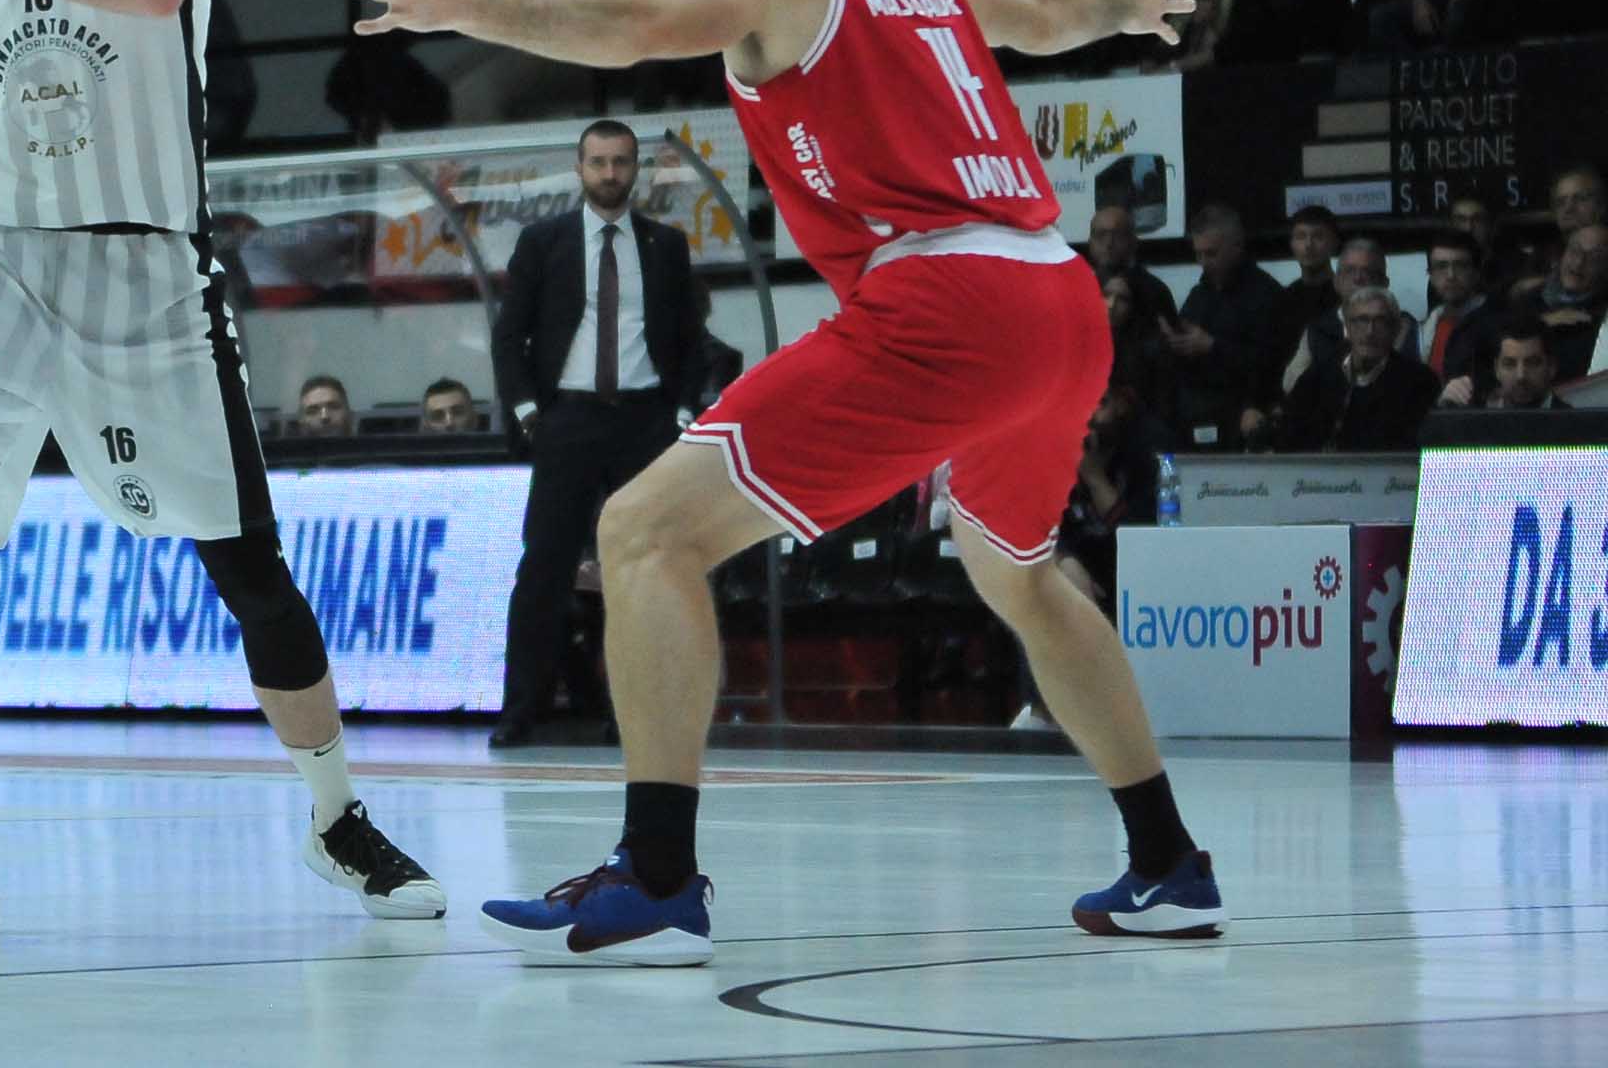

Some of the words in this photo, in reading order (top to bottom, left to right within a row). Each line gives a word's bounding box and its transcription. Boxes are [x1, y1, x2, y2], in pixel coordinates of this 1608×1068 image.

[74, 25, 120, 66] ACAI
[1399, 52, 1519, 91] FULVIO
[1399, 92, 1520, 132] PARQUET
[1399, 141, 1417, 172] &
[1426, 133, 1517, 171] RESINE
[800, 168, 839, 203] ASY
[952, 154, 1042, 200] IMOLA
[100, 425, 138, 465] 16
[1497, 502, 1575, 670] DA
